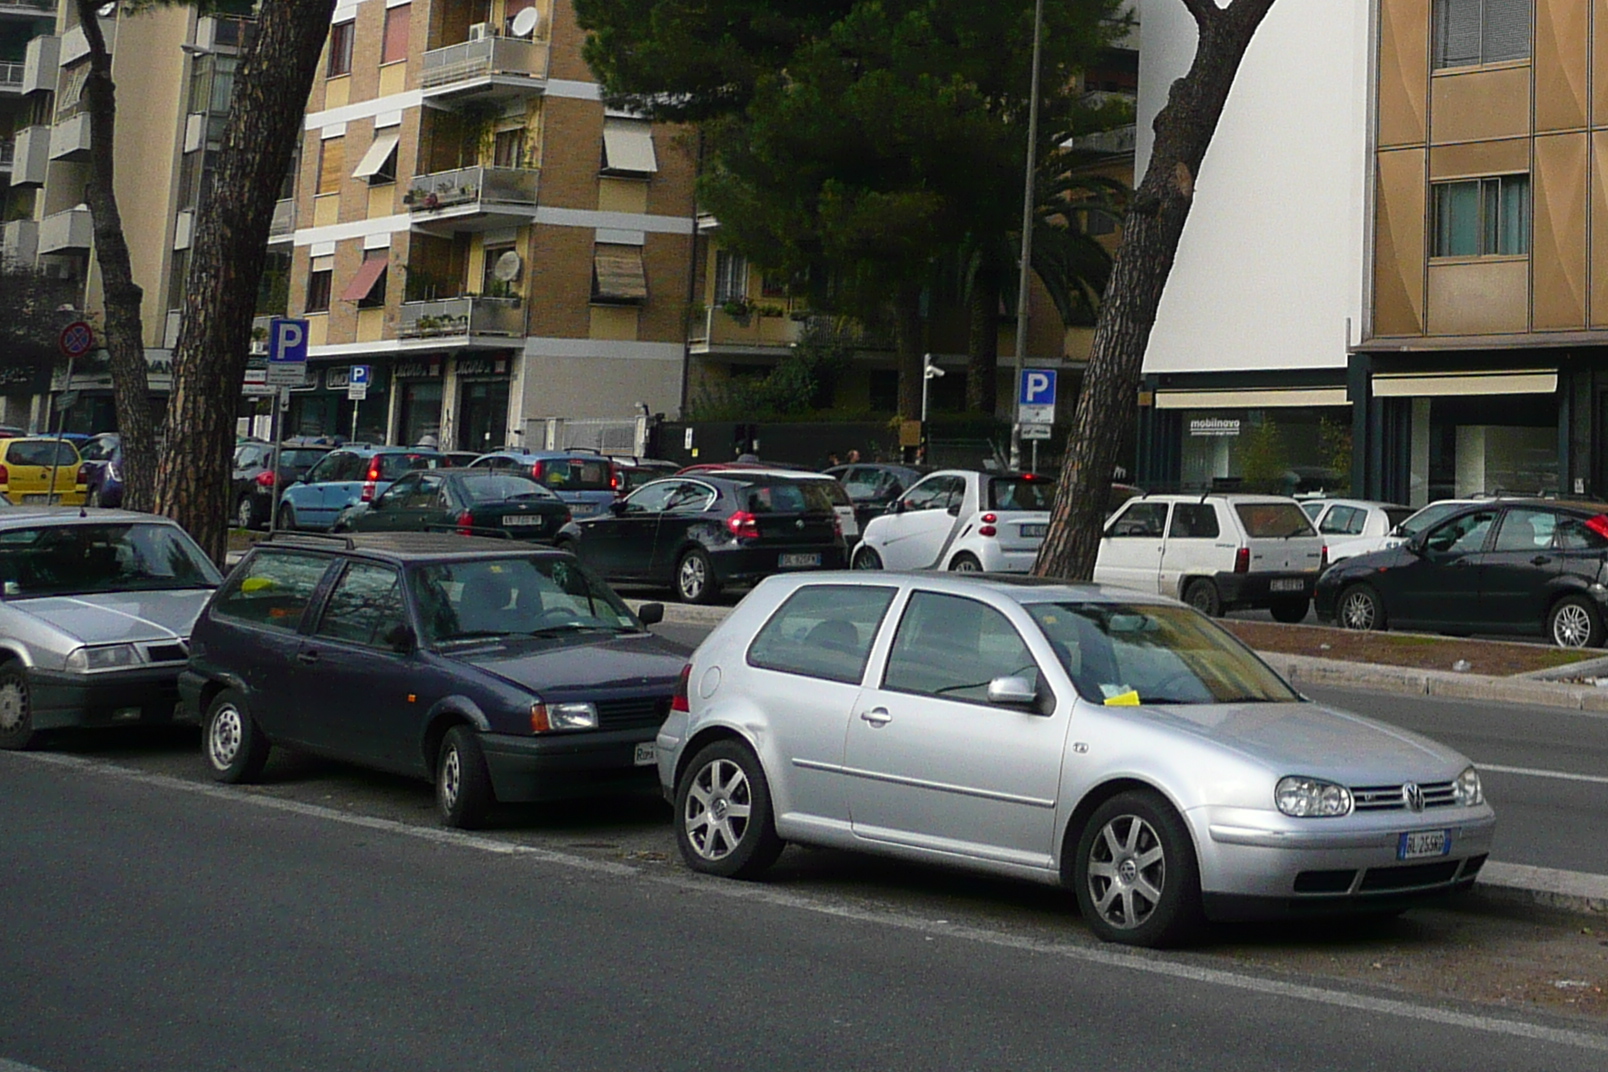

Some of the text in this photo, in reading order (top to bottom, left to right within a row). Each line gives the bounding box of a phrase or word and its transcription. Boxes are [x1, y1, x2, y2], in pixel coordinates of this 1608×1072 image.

[277, 323, 303, 359] P
[353, 367, 365, 382] P
[1026, 373, 1049, 401] P
